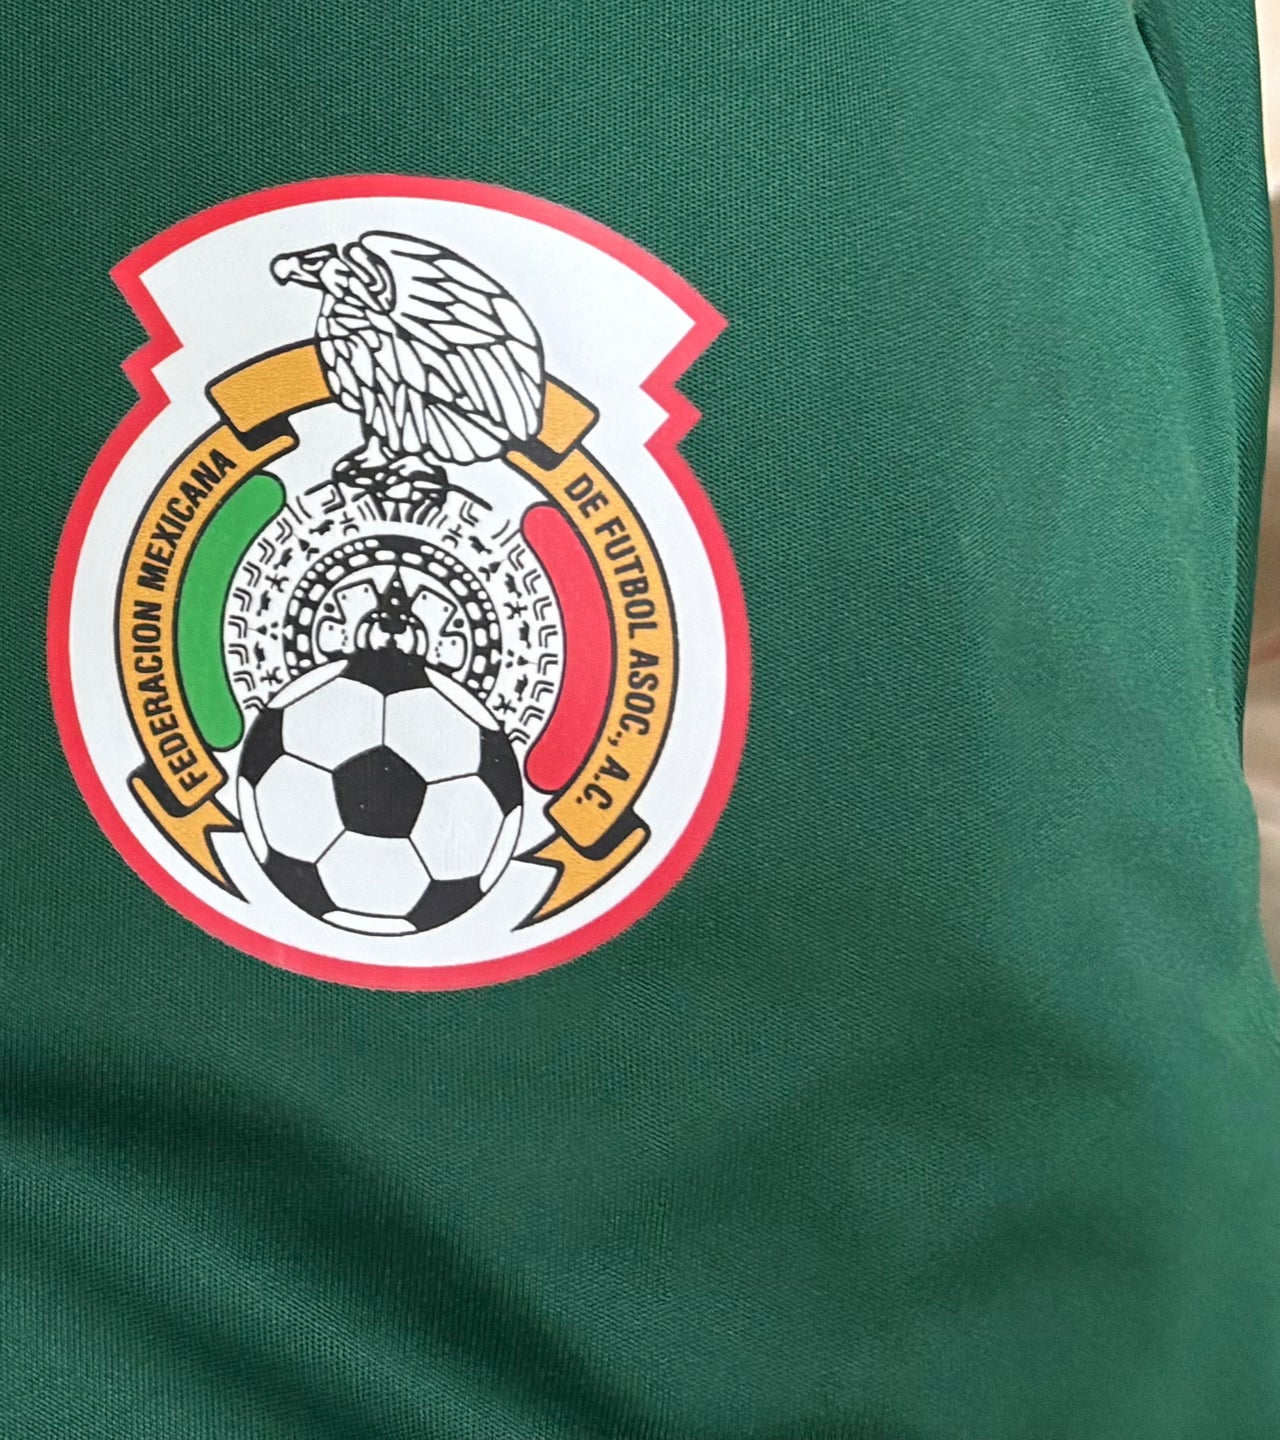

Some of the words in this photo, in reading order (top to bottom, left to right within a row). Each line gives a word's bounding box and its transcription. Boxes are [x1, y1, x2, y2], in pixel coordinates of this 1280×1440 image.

[137, 448, 238, 592] MEXICANA
[562, 472, 610, 520] DE
[594, 517, 658, 640] FUTBOL
[132, 601, 208, 792] FEDERACION
[575, 753, 631, 812] A.C.
